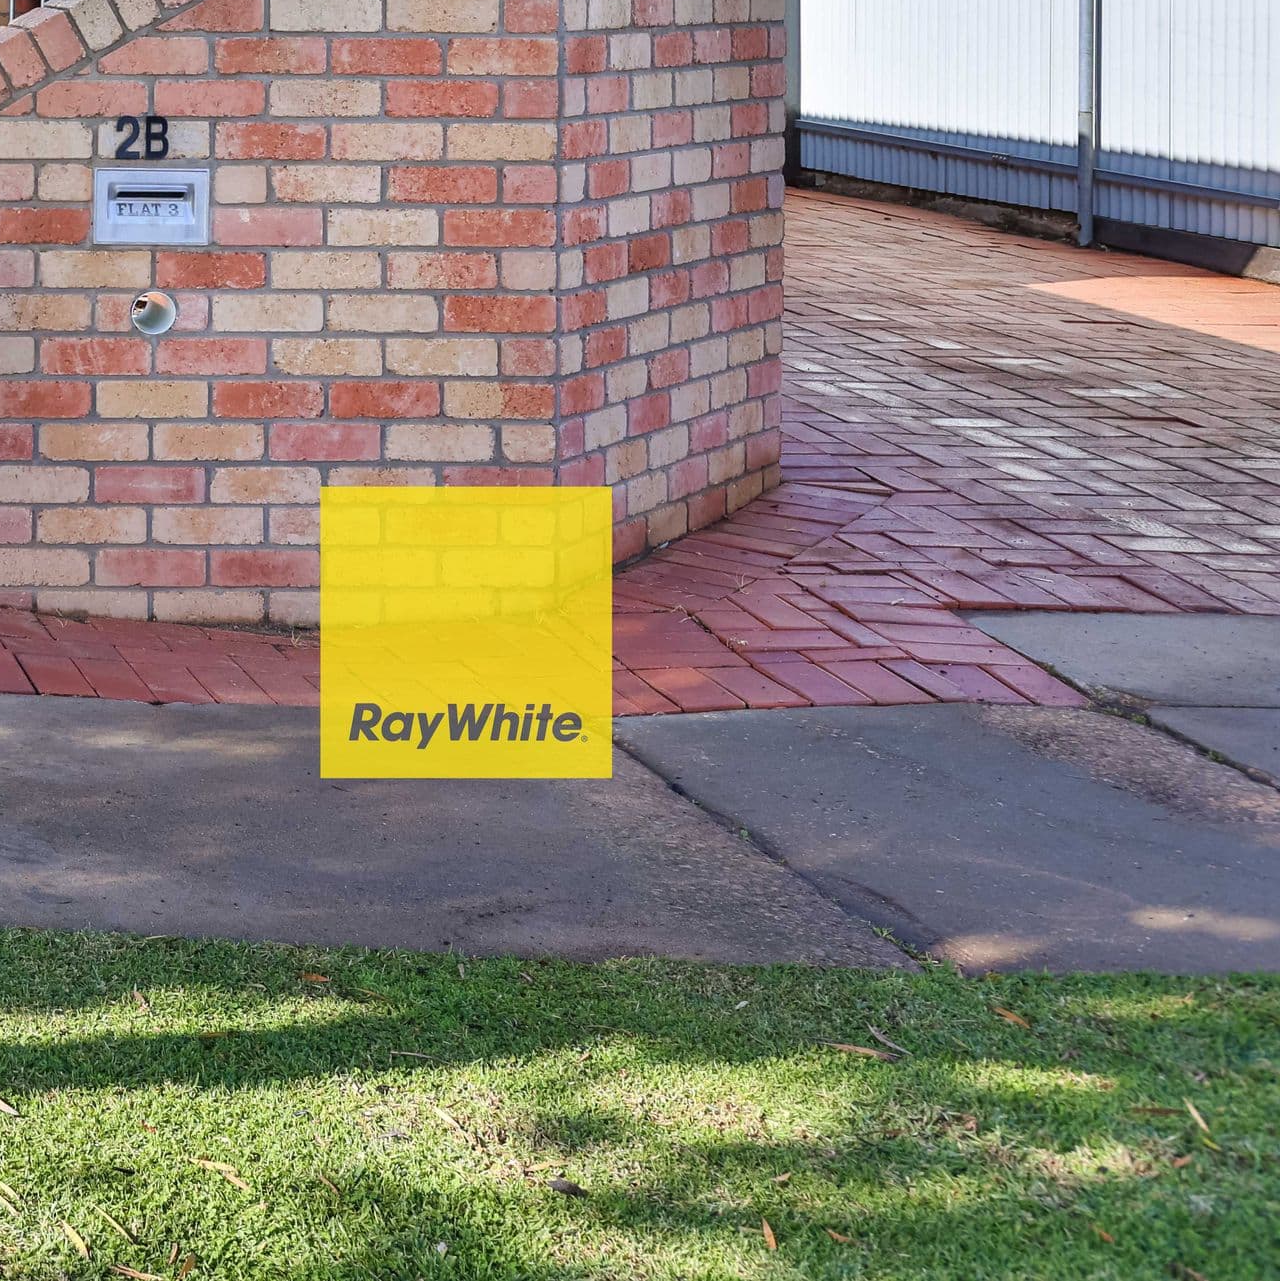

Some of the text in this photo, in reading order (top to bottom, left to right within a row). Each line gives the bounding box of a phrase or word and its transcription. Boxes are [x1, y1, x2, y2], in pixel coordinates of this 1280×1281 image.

[115, 115, 169, 160] 2B
[116, 203, 179, 217] FLAT 3
